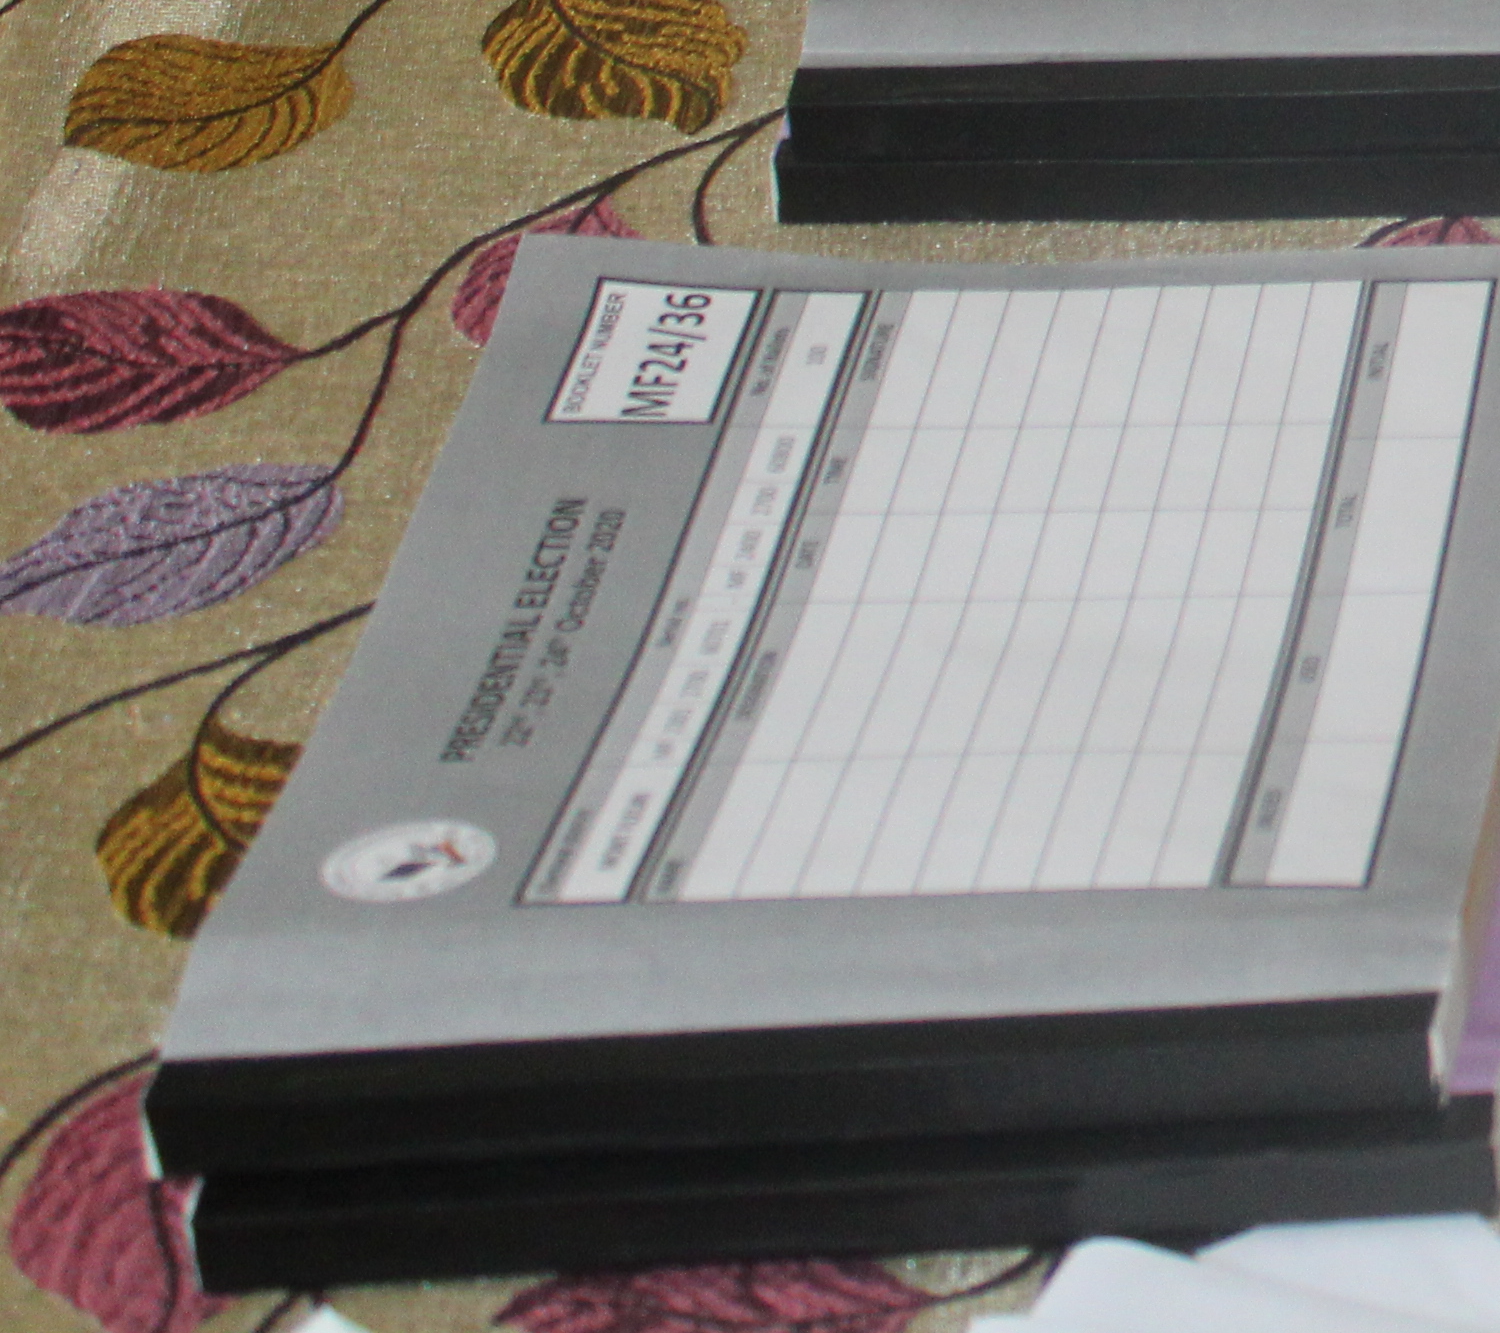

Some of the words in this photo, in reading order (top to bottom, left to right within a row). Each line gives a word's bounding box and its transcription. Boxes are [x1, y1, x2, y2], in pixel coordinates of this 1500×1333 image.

[585, 291, 629, 352] NUMBER
[620, 293, 713, 418] MF24/36
[565, 354, 611, 415] BOOKLET
[439, 611, 549, 763] PRESIDENTIAL
[514, 496, 589, 610] ELECTION
[556, 555, 612, 633] October
[587, 507, 627, 552] 2020
